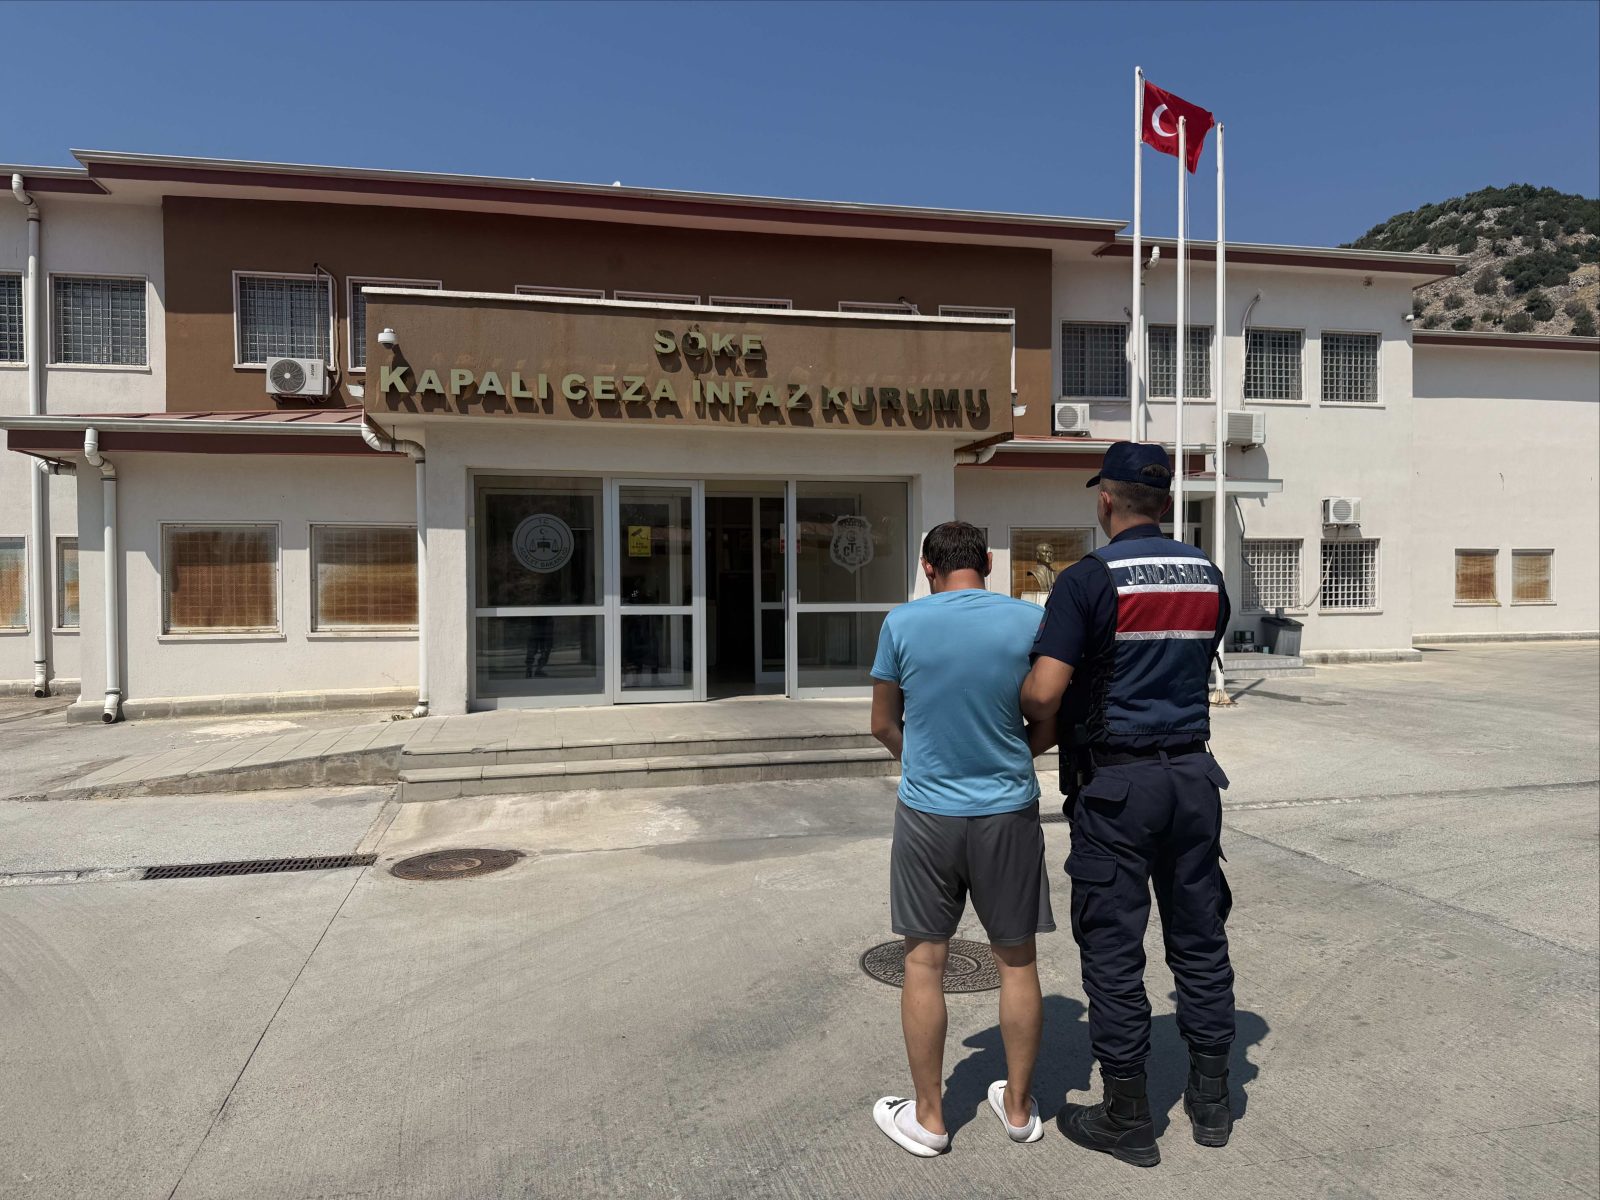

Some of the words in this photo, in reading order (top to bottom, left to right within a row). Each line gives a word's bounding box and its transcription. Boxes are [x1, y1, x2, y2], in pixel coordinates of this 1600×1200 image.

[380, 365, 548, 399] KAPALI
[561, 373, 678, 402] CEZA
[821, 385, 988, 414] KURUMU
[1125, 563, 1212, 585] JANDARMA
